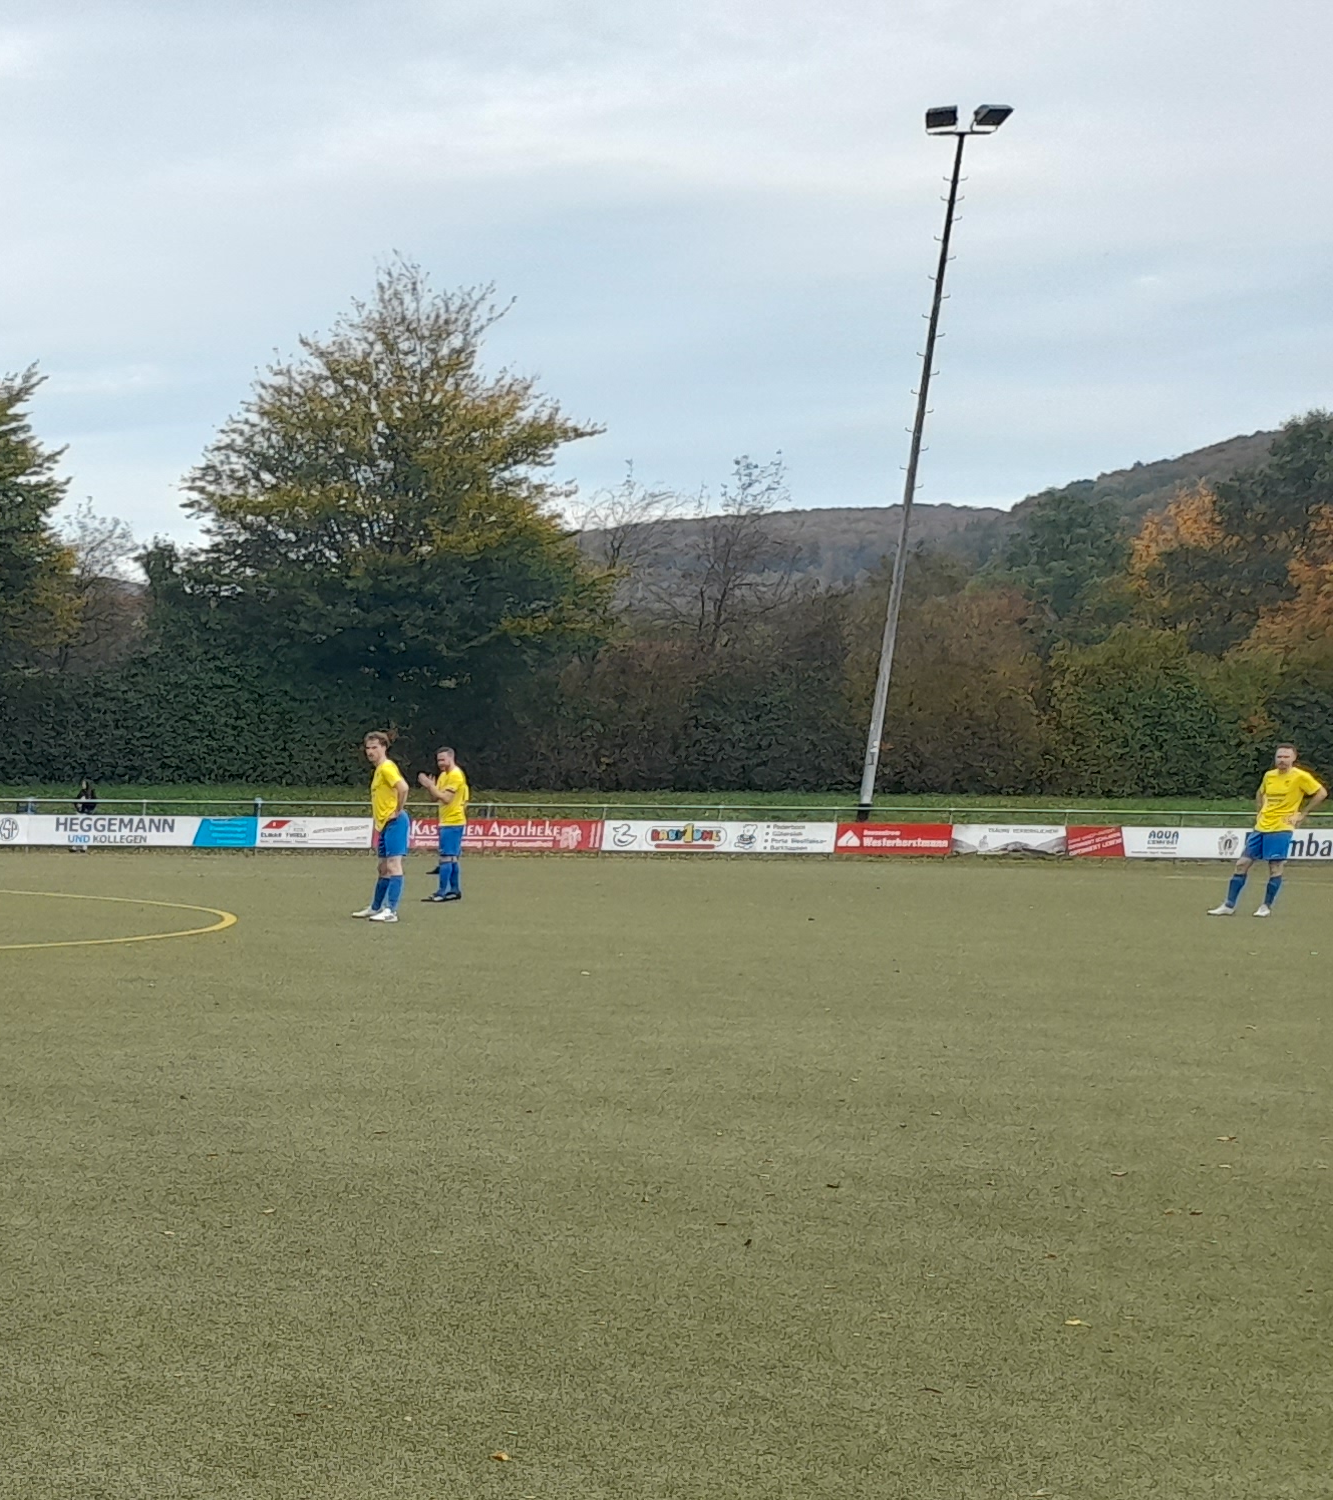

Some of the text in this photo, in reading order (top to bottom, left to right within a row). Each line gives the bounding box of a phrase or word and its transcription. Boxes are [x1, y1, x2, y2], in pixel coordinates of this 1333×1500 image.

[55, 817, 175, 833] HEGGEMANN
[1148, 830, 1179, 839] AQUA
[67, 835, 147, 844] UND KOLLEGEN
